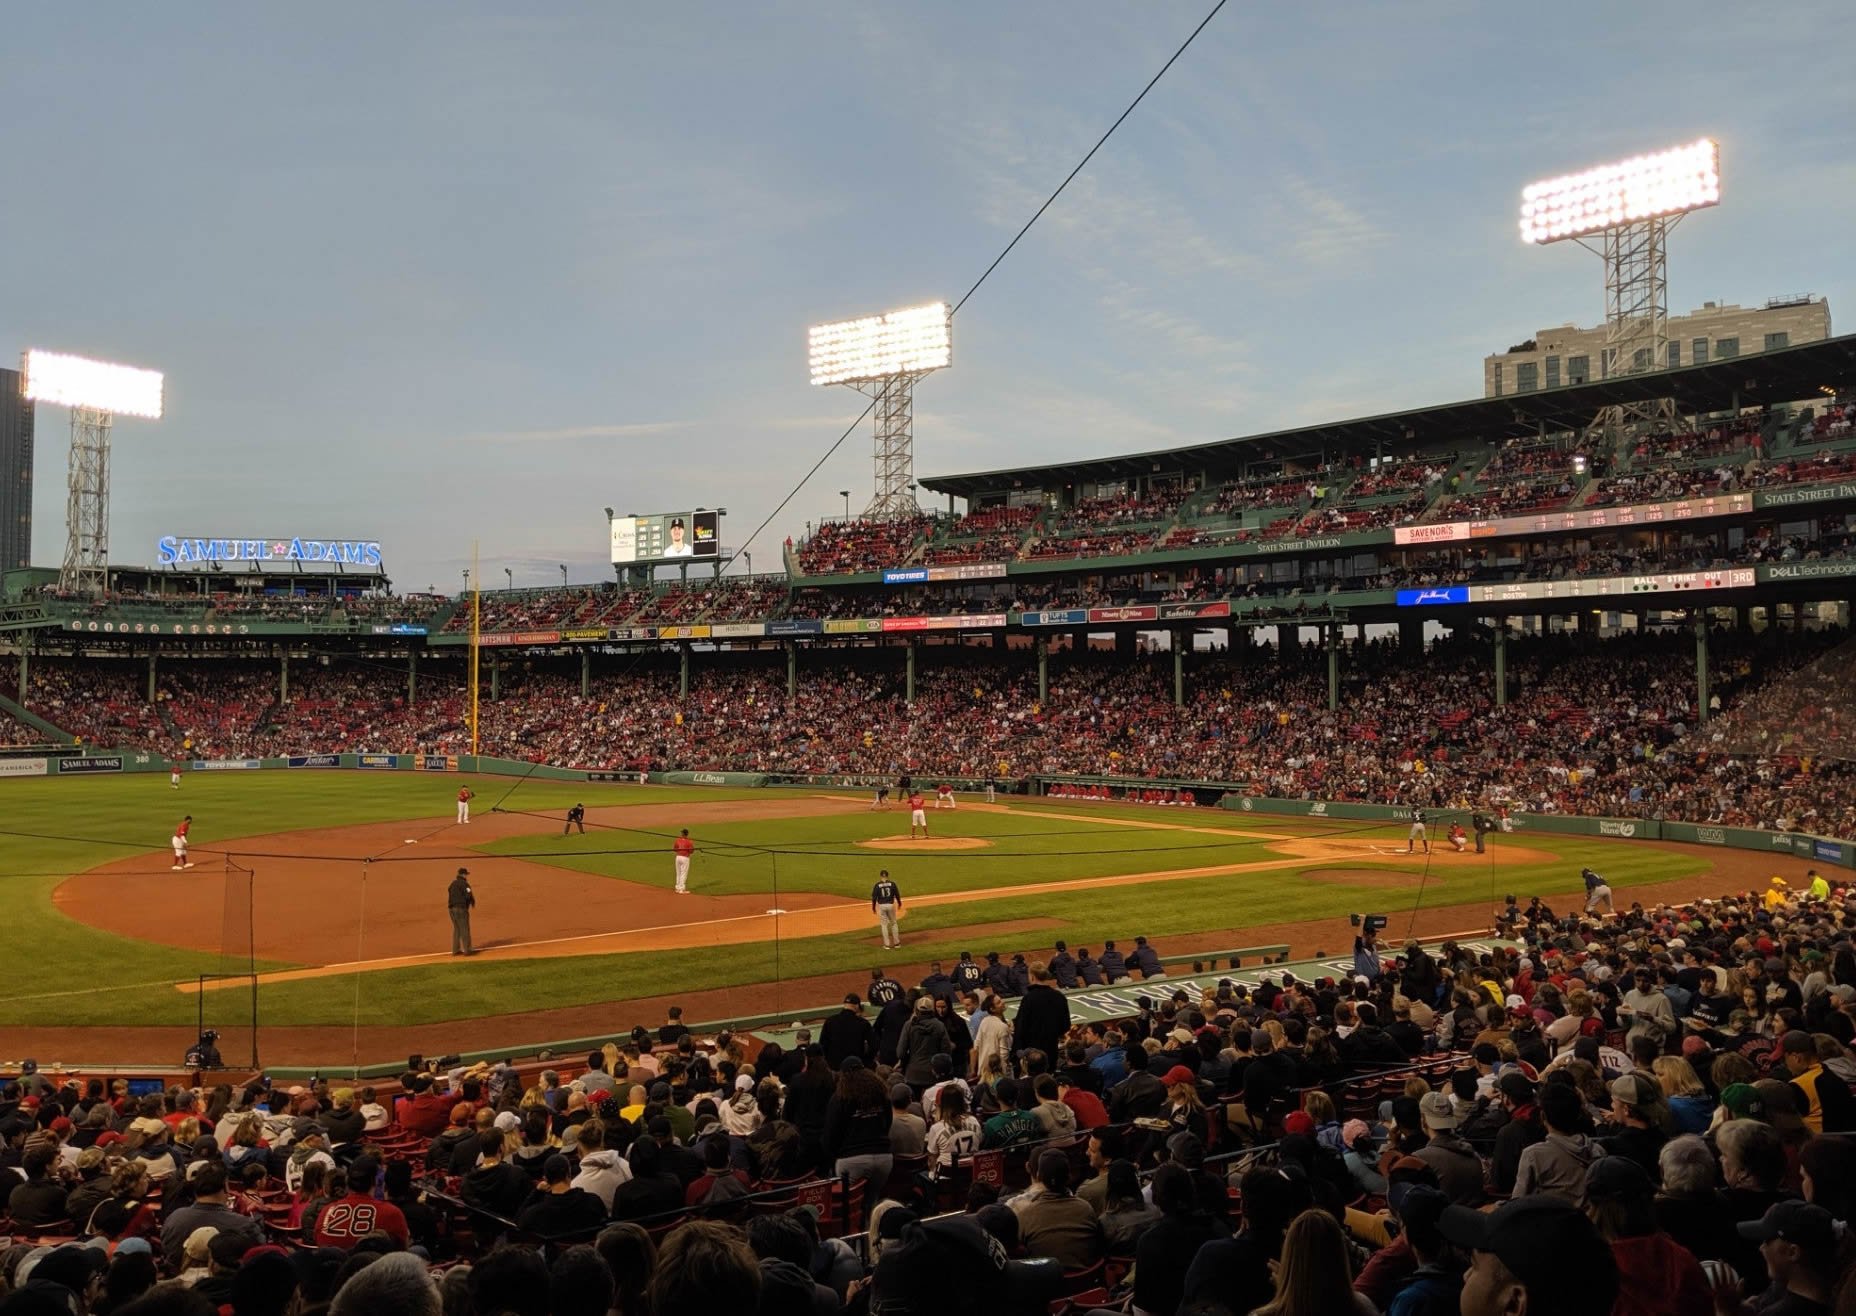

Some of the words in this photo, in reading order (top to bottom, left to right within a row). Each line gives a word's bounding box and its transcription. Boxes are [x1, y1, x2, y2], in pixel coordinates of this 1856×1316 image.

[1764, 493, 1796, 505] STATE
[1797, 488, 1837, 501] STREET
[1409, 525, 1454, 538] SAVENOR'S
[158, 535, 274, 565] SAMUEL
[284, 536, 382, 567] ADAMS
[1257, 543, 1278, 553] STATE
[1279, 541, 1304, 552] STREET
[1305, 538, 1341, 549] PAVILION
[886, 573, 906, 581] TOYO
[906, 571, 926, 579] TIRES
[1667, 573, 1697, 583] STRIKE
[1704, 571, 1722, 580] OUT
[1732, 571, 1753, 584] 3RD
[1769, 567, 1800, 578] DELL
[1634, 577, 1657, 585] BALL
[1502, 592, 1528, 600] BOSTON
[1166, 608, 1196, 617] Safelite
[62, 760, 91, 770] SAMUEL
[93, 758, 120, 768] ADAMS
[135, 755, 150, 764] 380
[881, 887, 891, 897] 13
[965, 967, 979, 979] 89
[880, 989, 895, 1003] 10
[955, 1136, 974, 1155] 17
[981, 1162, 995, 1170] BOX
[978, 1169, 998, 1182] 69
[804, 1187, 825, 1195] FIELD
[806, 1195, 822, 1203] BOX
[321, 1203, 377, 1237] 28
